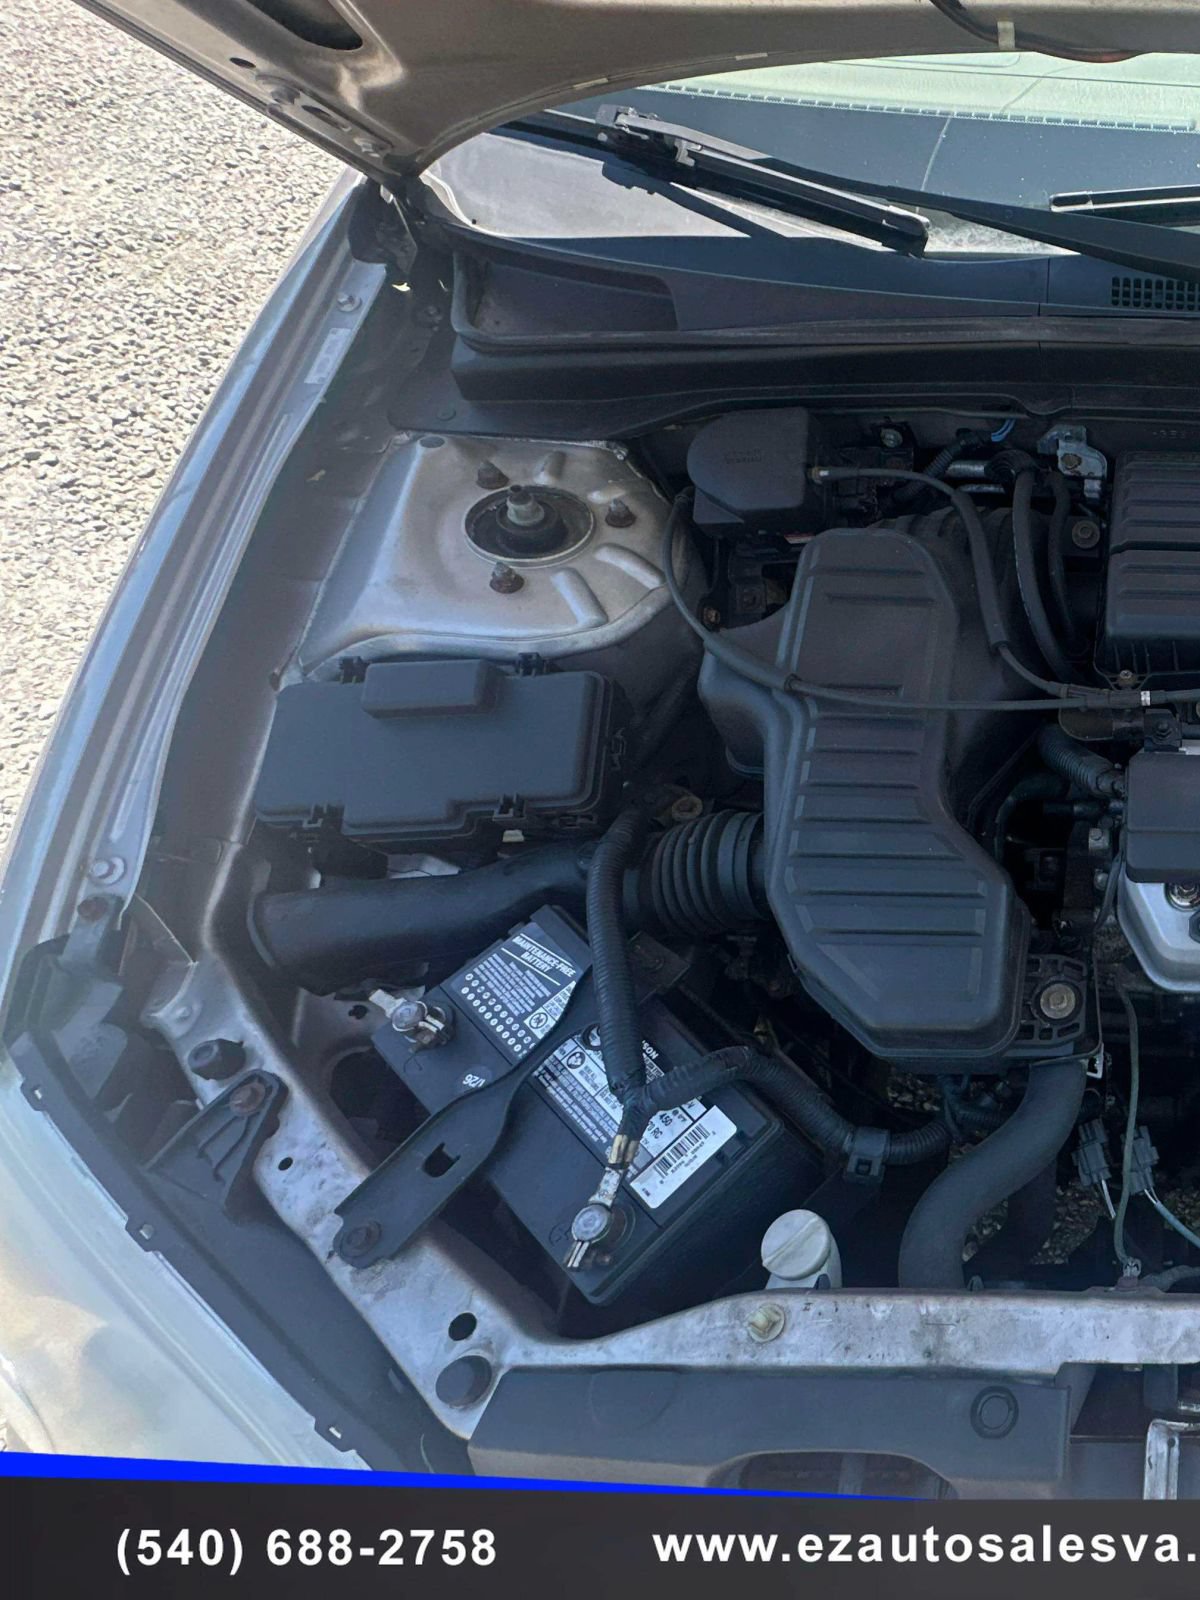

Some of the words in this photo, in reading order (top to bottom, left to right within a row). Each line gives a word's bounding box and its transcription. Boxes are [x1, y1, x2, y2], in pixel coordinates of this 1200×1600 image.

[512, 935, 576, 978] MAINTENANCE-FREE
[520, 950, 553, 974] BATTERY
[642, 1039, 659, 1060] SON
